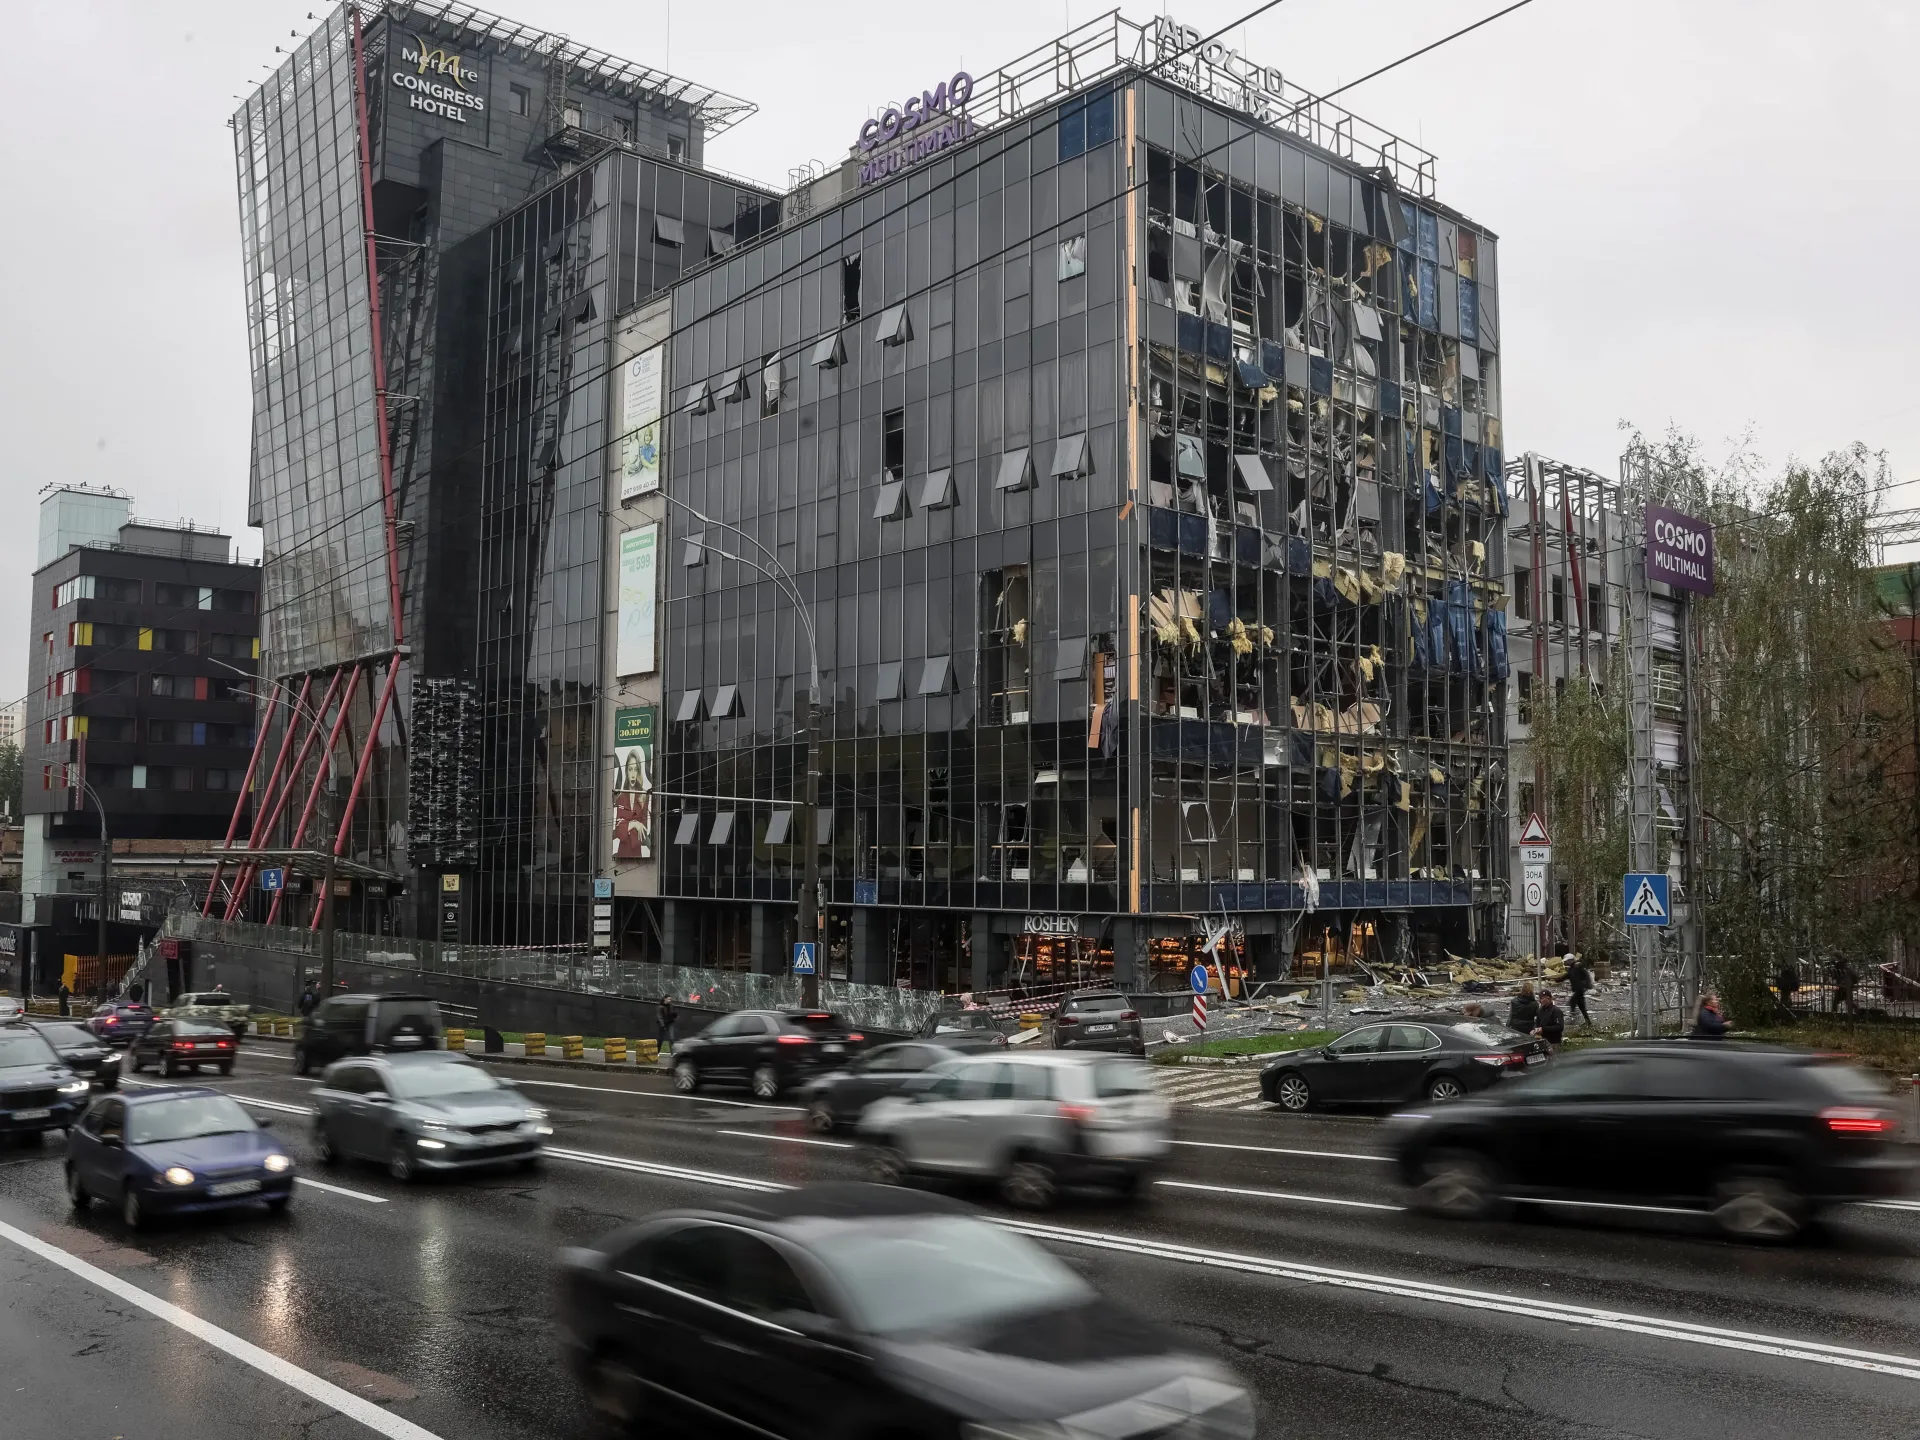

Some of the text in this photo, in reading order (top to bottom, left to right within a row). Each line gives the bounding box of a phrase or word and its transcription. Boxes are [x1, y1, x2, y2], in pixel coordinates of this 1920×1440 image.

[402, 47, 478, 83] Mercure
[392, 72, 484, 110] CONGRESS
[410, 94, 467, 122] HOTEL
[859, 72, 973, 150] COSMO
[1655, 519, 1706, 557] COSMO
[1655, 550, 1706, 581] MULTIMALL
[619, 727, 649, 737] ЗОЛОТО
[627, 719, 641, 727] УКР
[1527, 850, 1544, 859] 15м
[1525, 870, 1543, 879] ЗОНА
[1530, 890, 1538, 900] 10
[1024, 915, 1079, 934] ROSHEN
